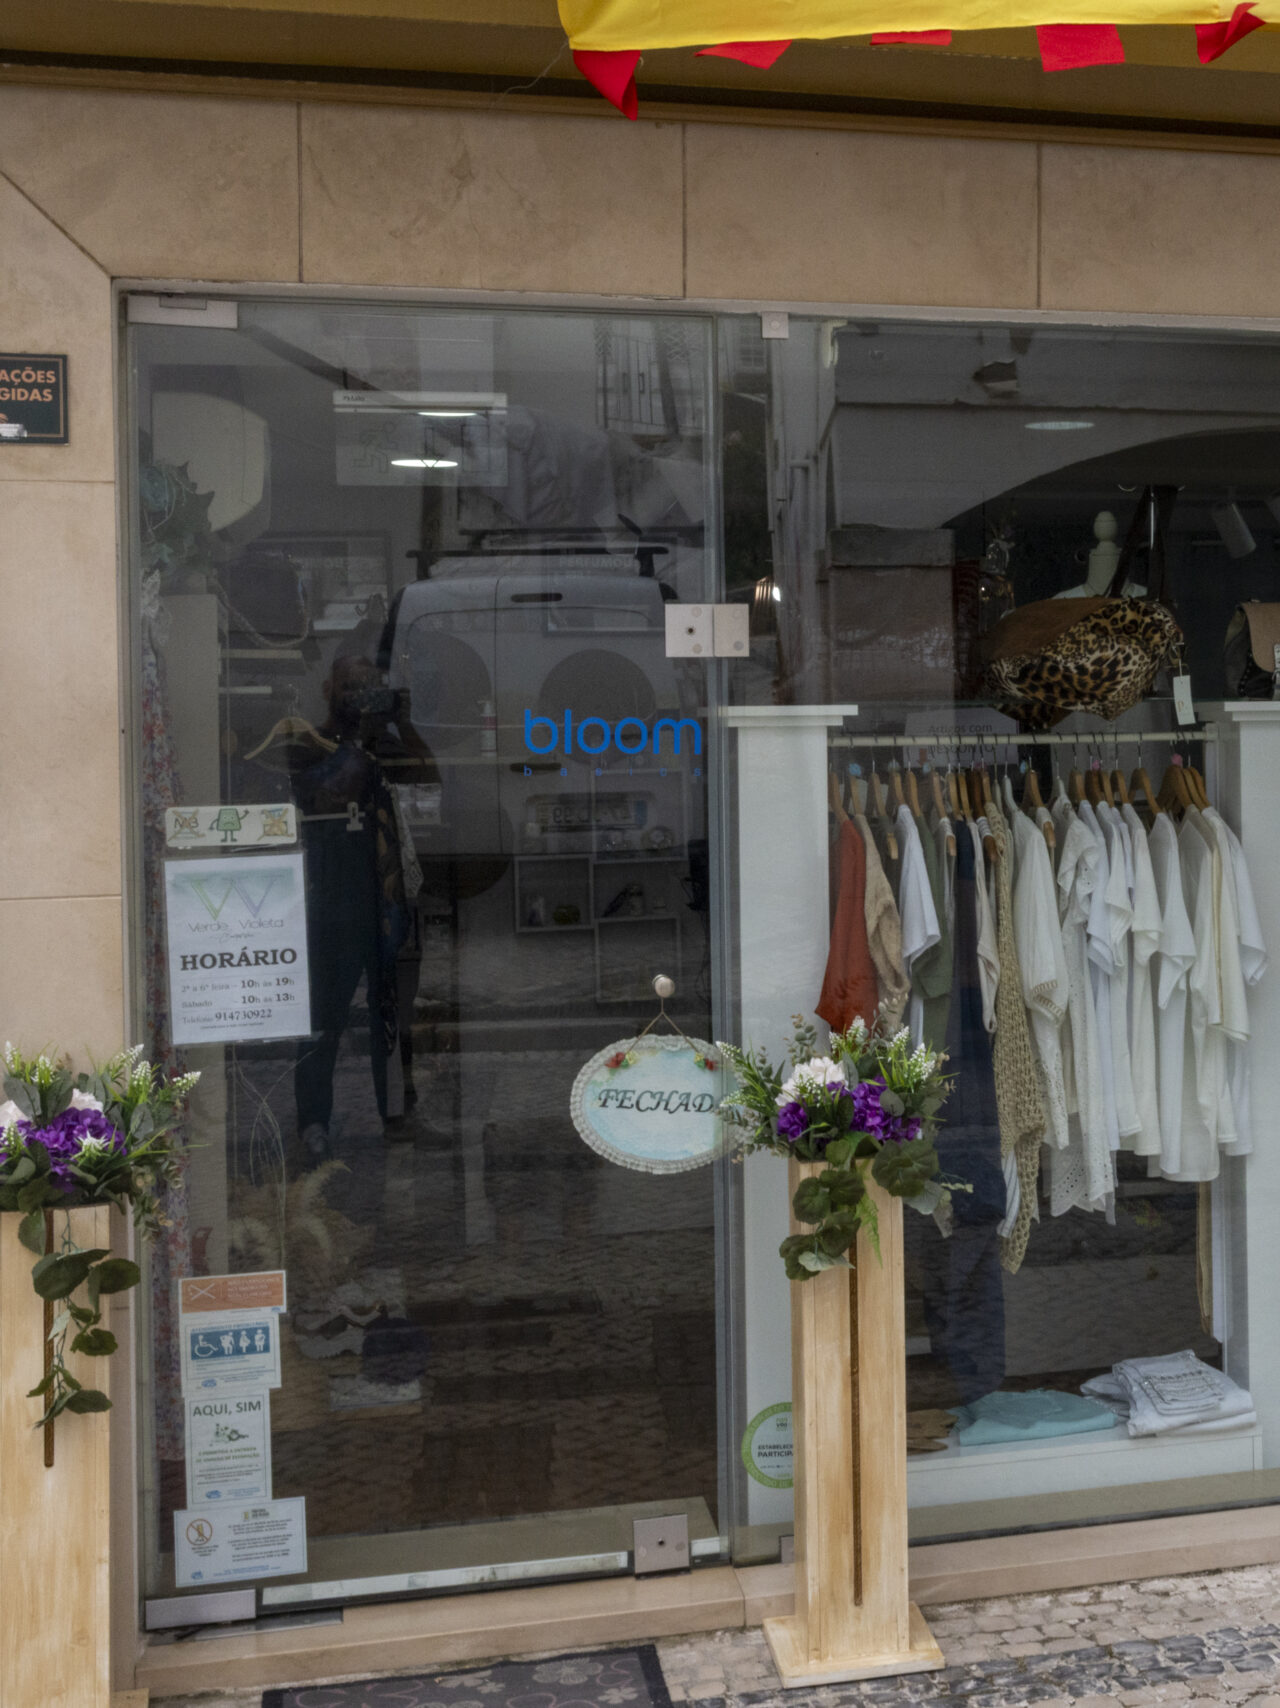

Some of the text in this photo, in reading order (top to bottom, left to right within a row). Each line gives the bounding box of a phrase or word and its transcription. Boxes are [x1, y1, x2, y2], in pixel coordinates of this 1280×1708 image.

[0, 366, 57, 386] AÇÕES
[0, 387, 54, 402] GIDAS
[524, 708, 702, 755] bloom
[969, 723, 993, 733] com
[187, 917, 285, 932] Verde Violeta
[180, 946, 298, 971] HORÁRIO
[241, 979, 261, 989] 10h
[275, 977, 295, 986] 19h
[241, 995, 262, 1004] 10h
[275, 993, 295, 1002] 13h
[215, 1008, 273, 1021] 914730922
[598, 1088, 716, 1115] FECHAD
[193, 1401, 262, 1417] AQUI, SIM
